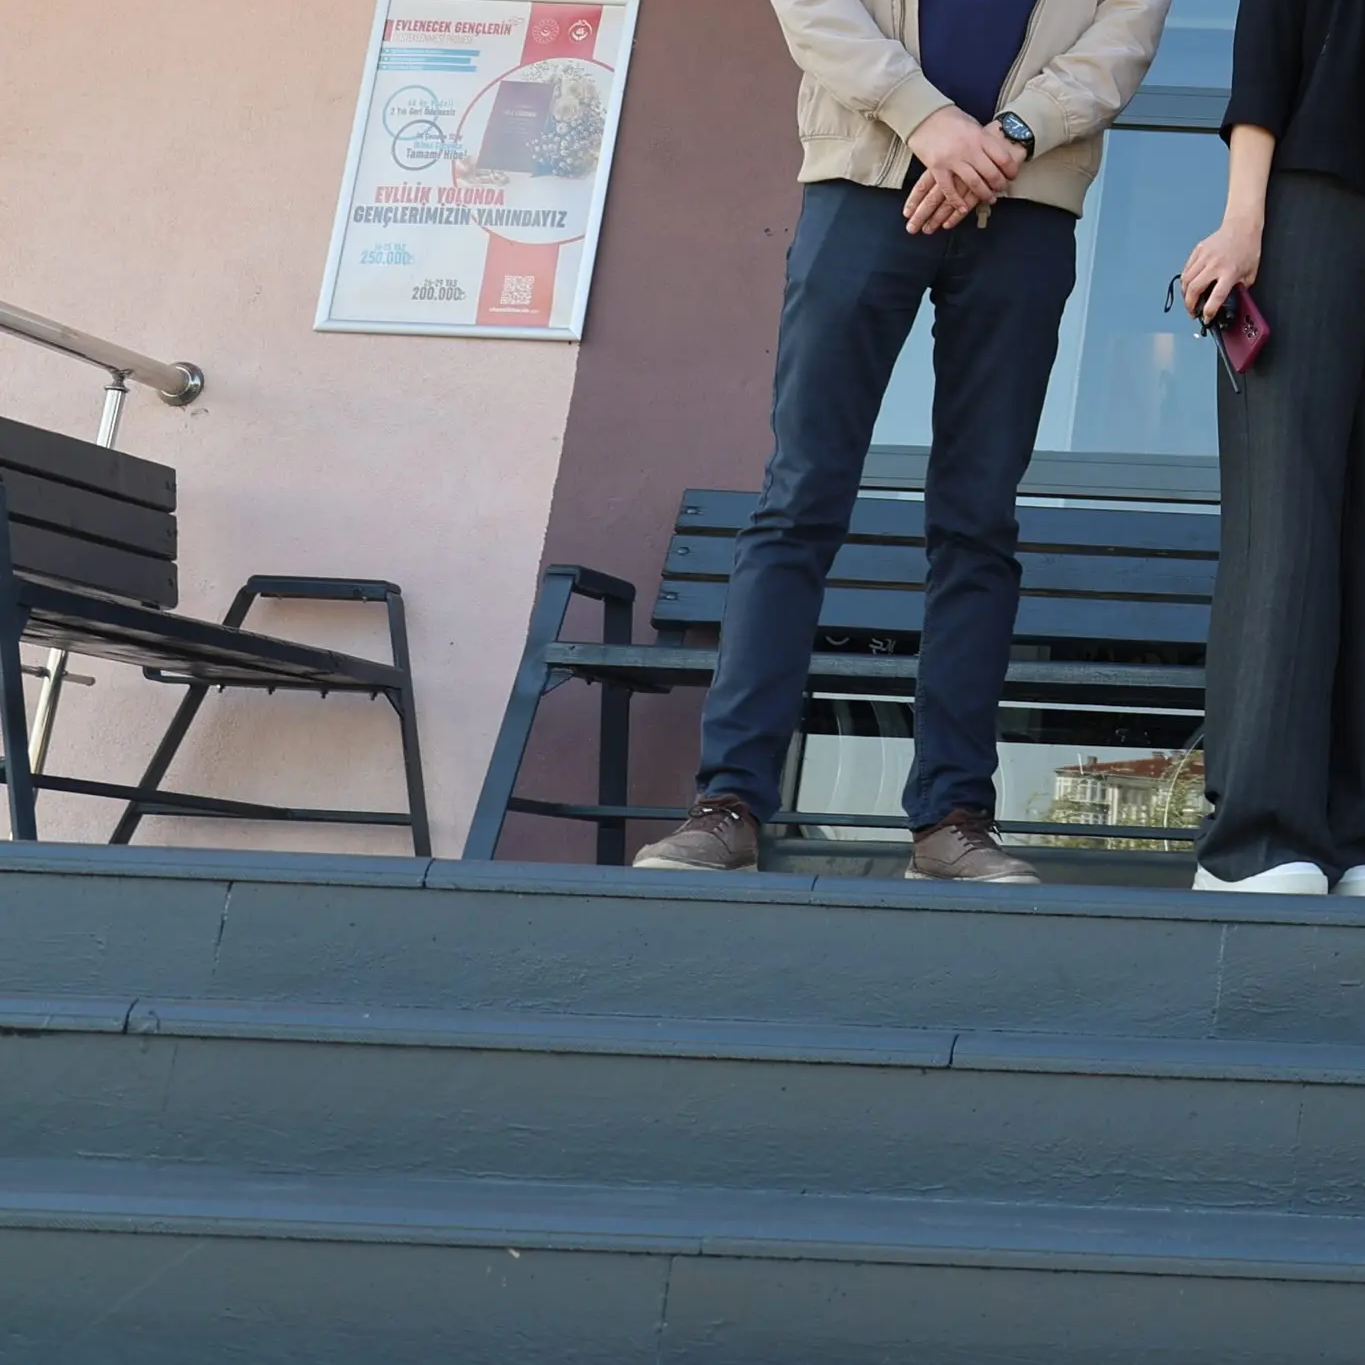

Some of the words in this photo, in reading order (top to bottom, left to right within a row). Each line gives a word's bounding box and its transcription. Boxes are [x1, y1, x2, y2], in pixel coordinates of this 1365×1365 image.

[395, 19, 452, 33] EVLENECEK
[455, 20, 512, 37] GENÇLERİN
[375, 182, 430, 204] EVLİLİK
[437, 186, 505, 205] YOLUNDA
[353, 203, 471, 228] GENÇLERİMİZİN
[476, 209, 568, 228] YANINDAYIZ
